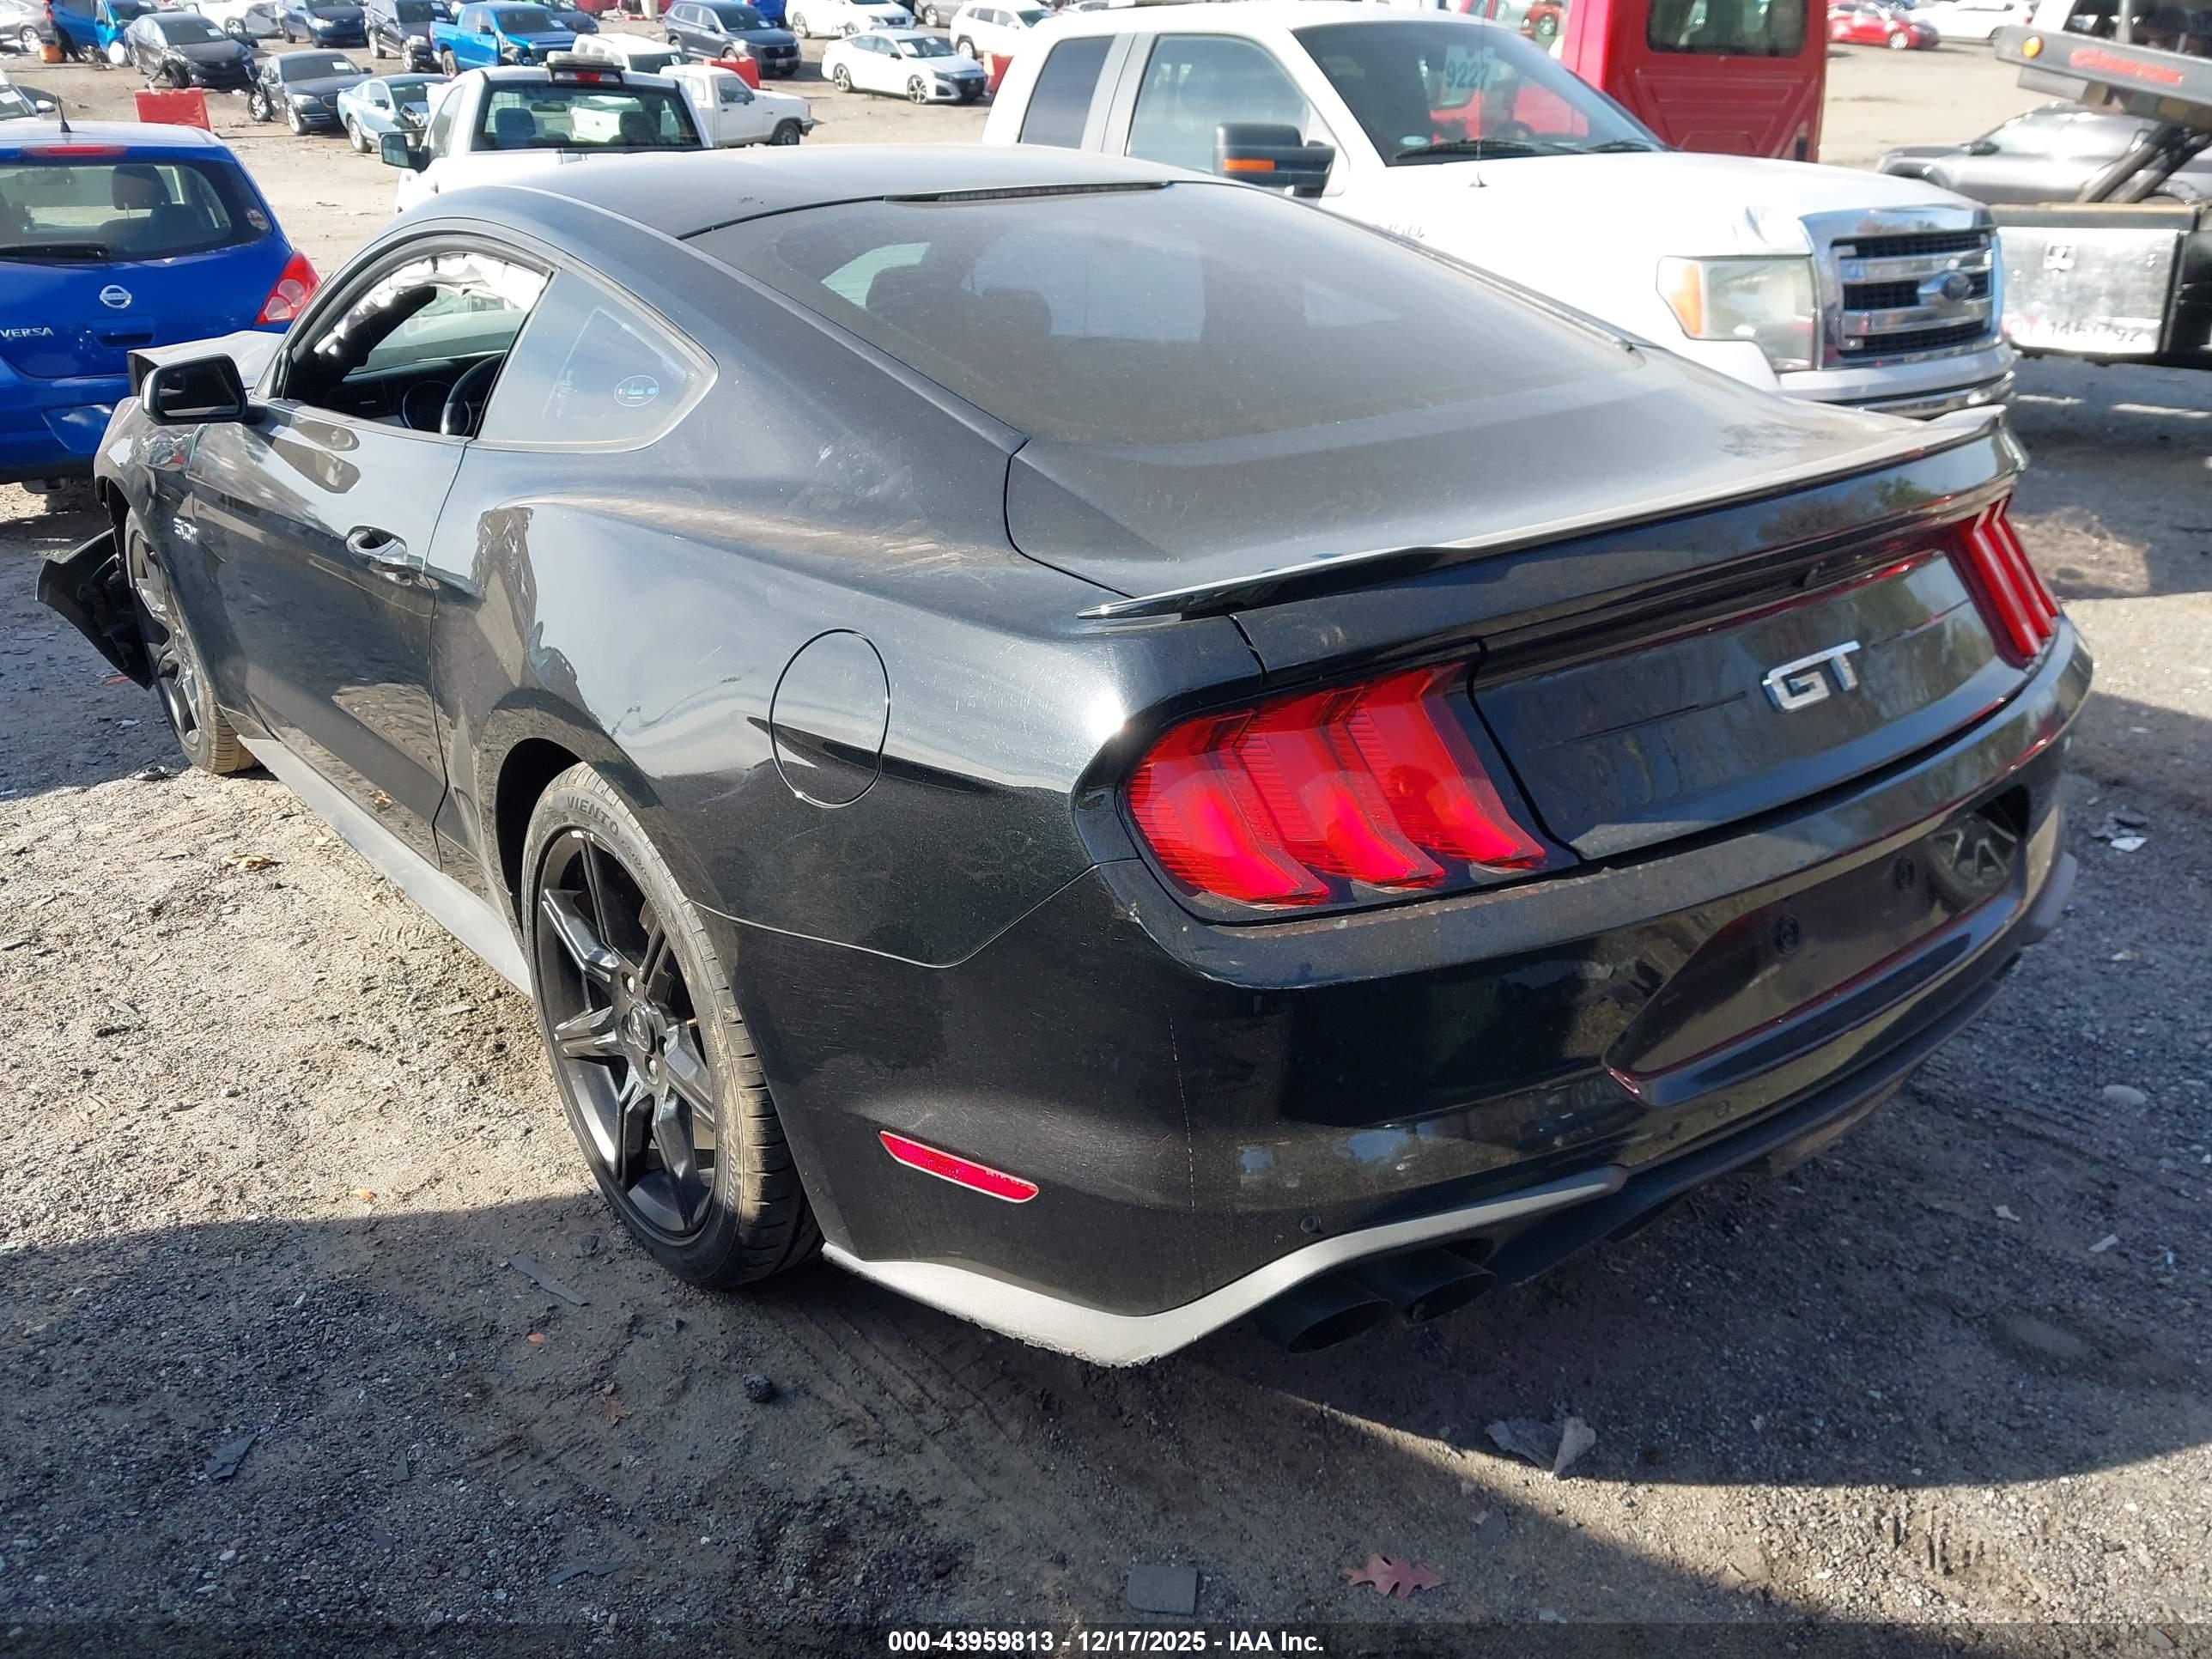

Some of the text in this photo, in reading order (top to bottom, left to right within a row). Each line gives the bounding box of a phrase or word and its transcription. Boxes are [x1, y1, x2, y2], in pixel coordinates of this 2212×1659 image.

[0, 327, 54, 337] VERSA
[1762, 640, 1862, 711] GT
[567, 796, 618, 837] VIENTO
